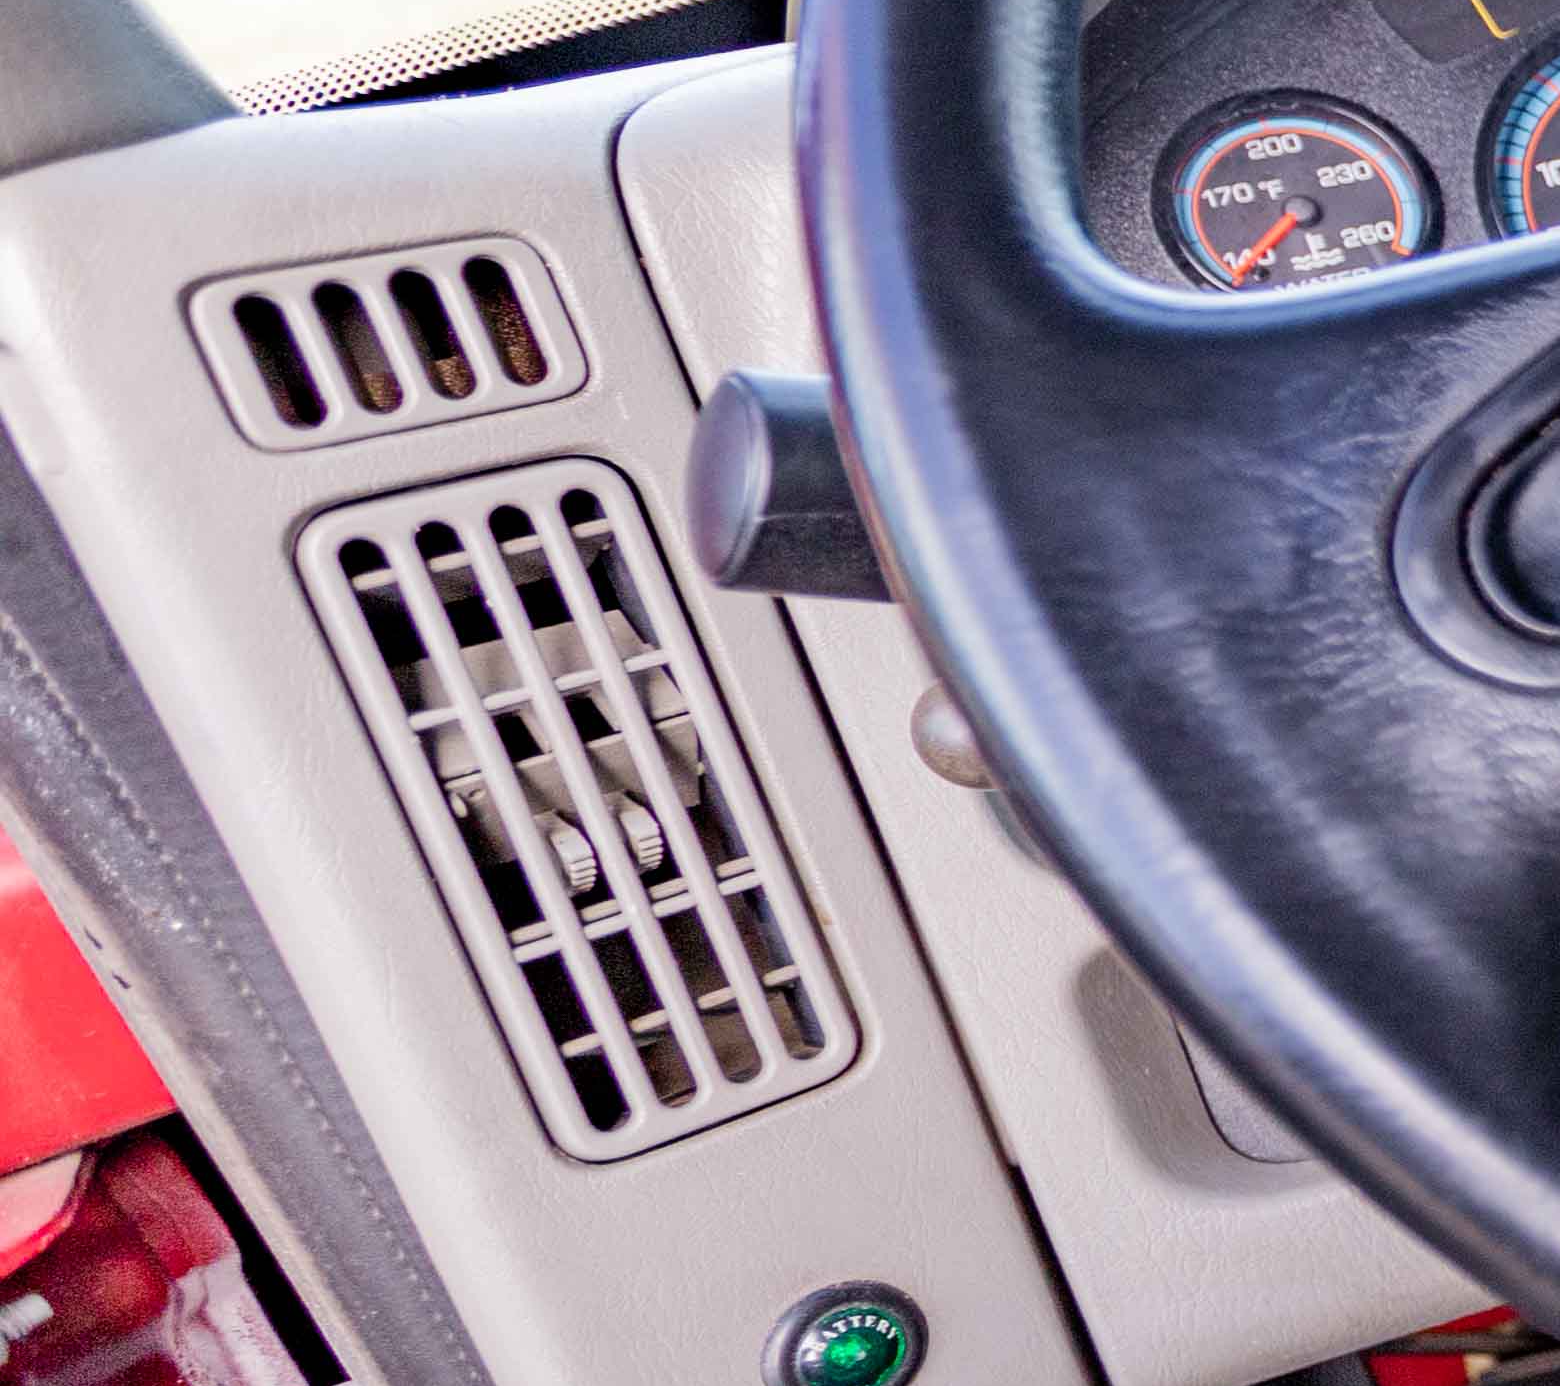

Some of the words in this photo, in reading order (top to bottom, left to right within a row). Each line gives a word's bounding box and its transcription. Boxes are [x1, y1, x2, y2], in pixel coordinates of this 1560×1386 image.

[1244, 132, 1303, 161] 200
[1316, 159, 1375, 189] 230
[1201, 181, 1256, 209] 170
[1339, 220, 1397, 249] 260
